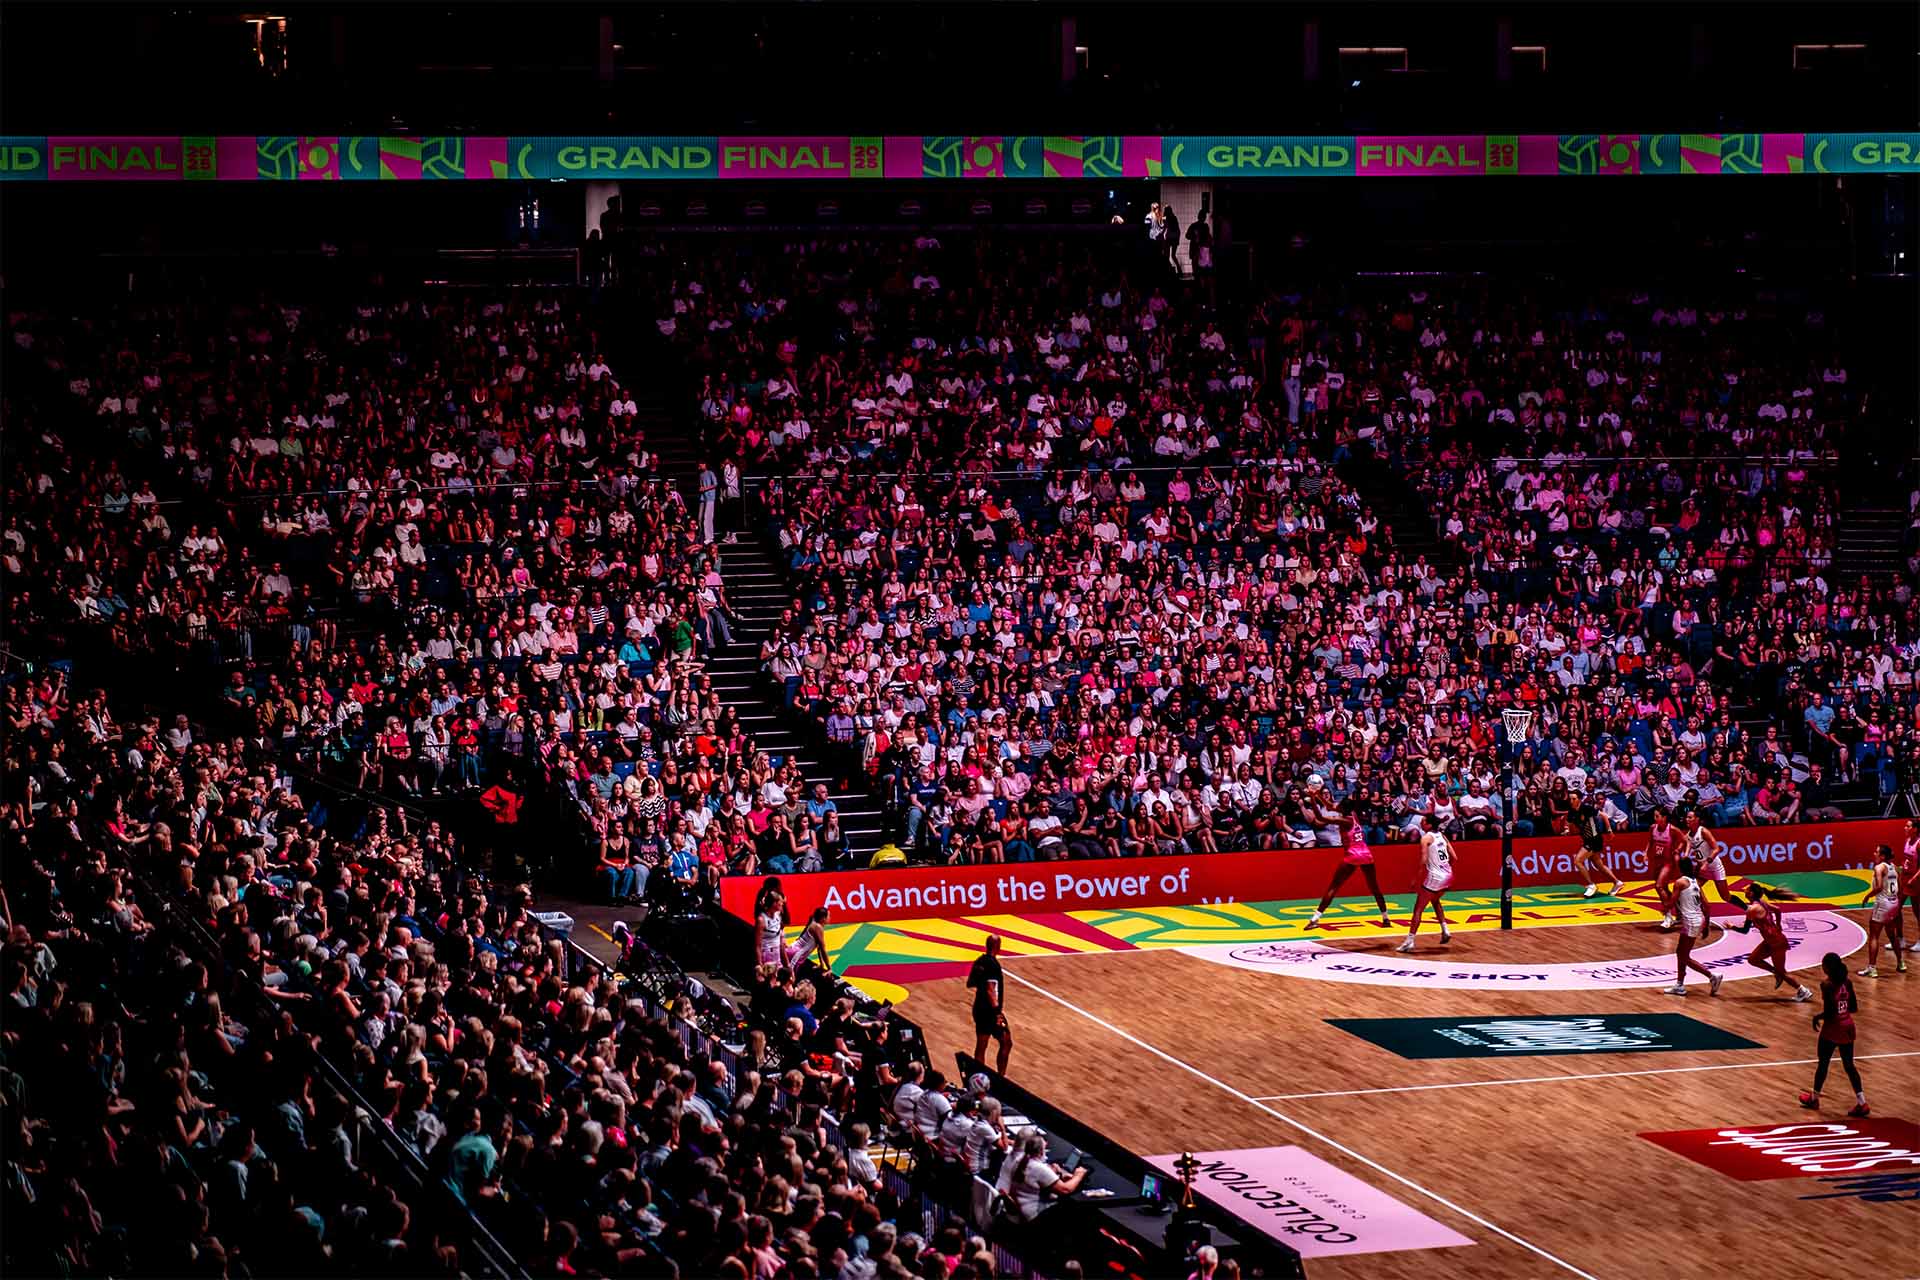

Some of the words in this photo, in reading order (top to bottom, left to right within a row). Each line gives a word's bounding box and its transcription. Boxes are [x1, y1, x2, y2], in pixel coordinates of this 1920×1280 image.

[53, 146, 177, 170] FINAL
[556, 146, 711, 171] GRAND
[724, 145, 844, 169] FINAL
[1206, 144, 1350, 169] GRAND
[1360, 144, 1480, 167] FINAL
[1806, 834, 1833, 860] of
[823, 880, 987, 910] Advancing
[997, 875, 1046, 902] the
[1055, 873, 1150, 900] Power
[1159, 866, 1190, 894] of
[1326, 964, 1437, 978] SUPER
[1448, 972, 1549, 981] SHOT
[1201, 1160, 1357, 1245] COLLECTION
